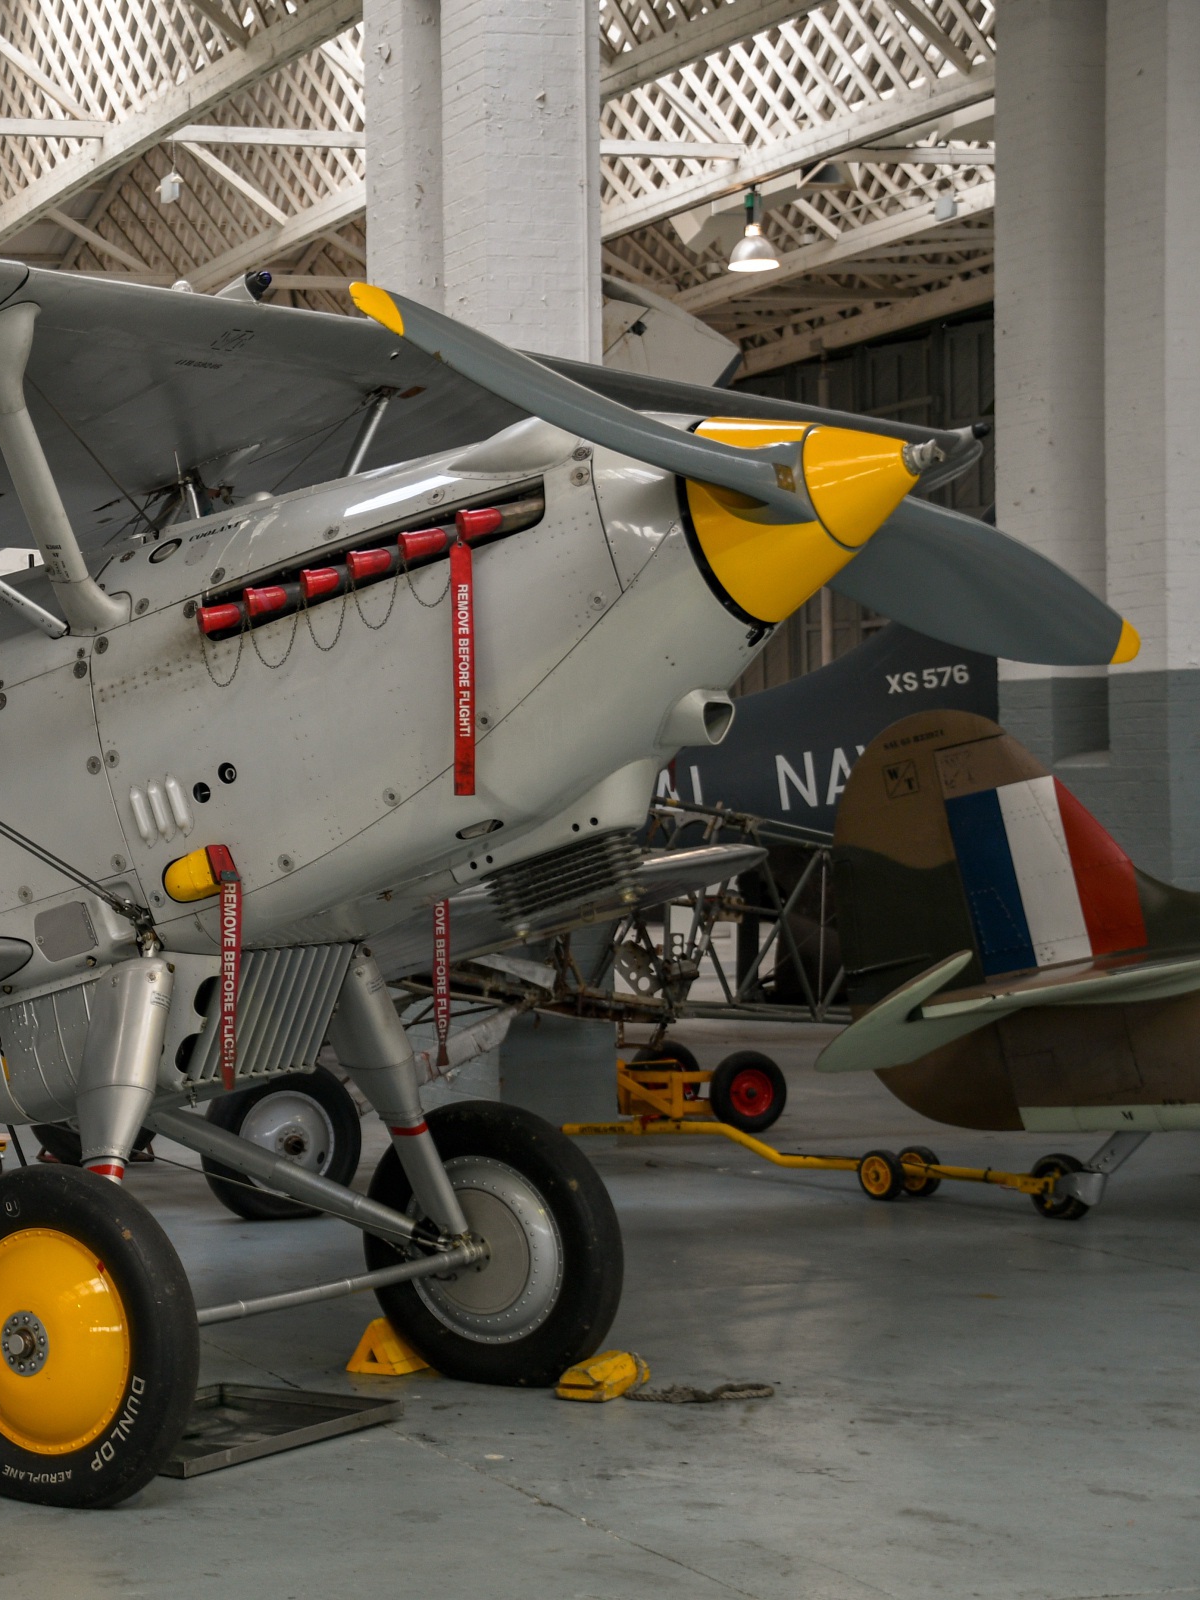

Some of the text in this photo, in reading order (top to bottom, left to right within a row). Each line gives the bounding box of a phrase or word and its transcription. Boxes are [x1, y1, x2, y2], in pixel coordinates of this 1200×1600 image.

[457, 584, 471, 737] REMOVE BEFORE FLIGHT!
[223, 883, 237, 1069] REMOVE BEFORE FLIGHT
[436, 938, 447, 995] BEFORE
[2, 1375, 146, 1484] DUNLOP AEROPLANE
